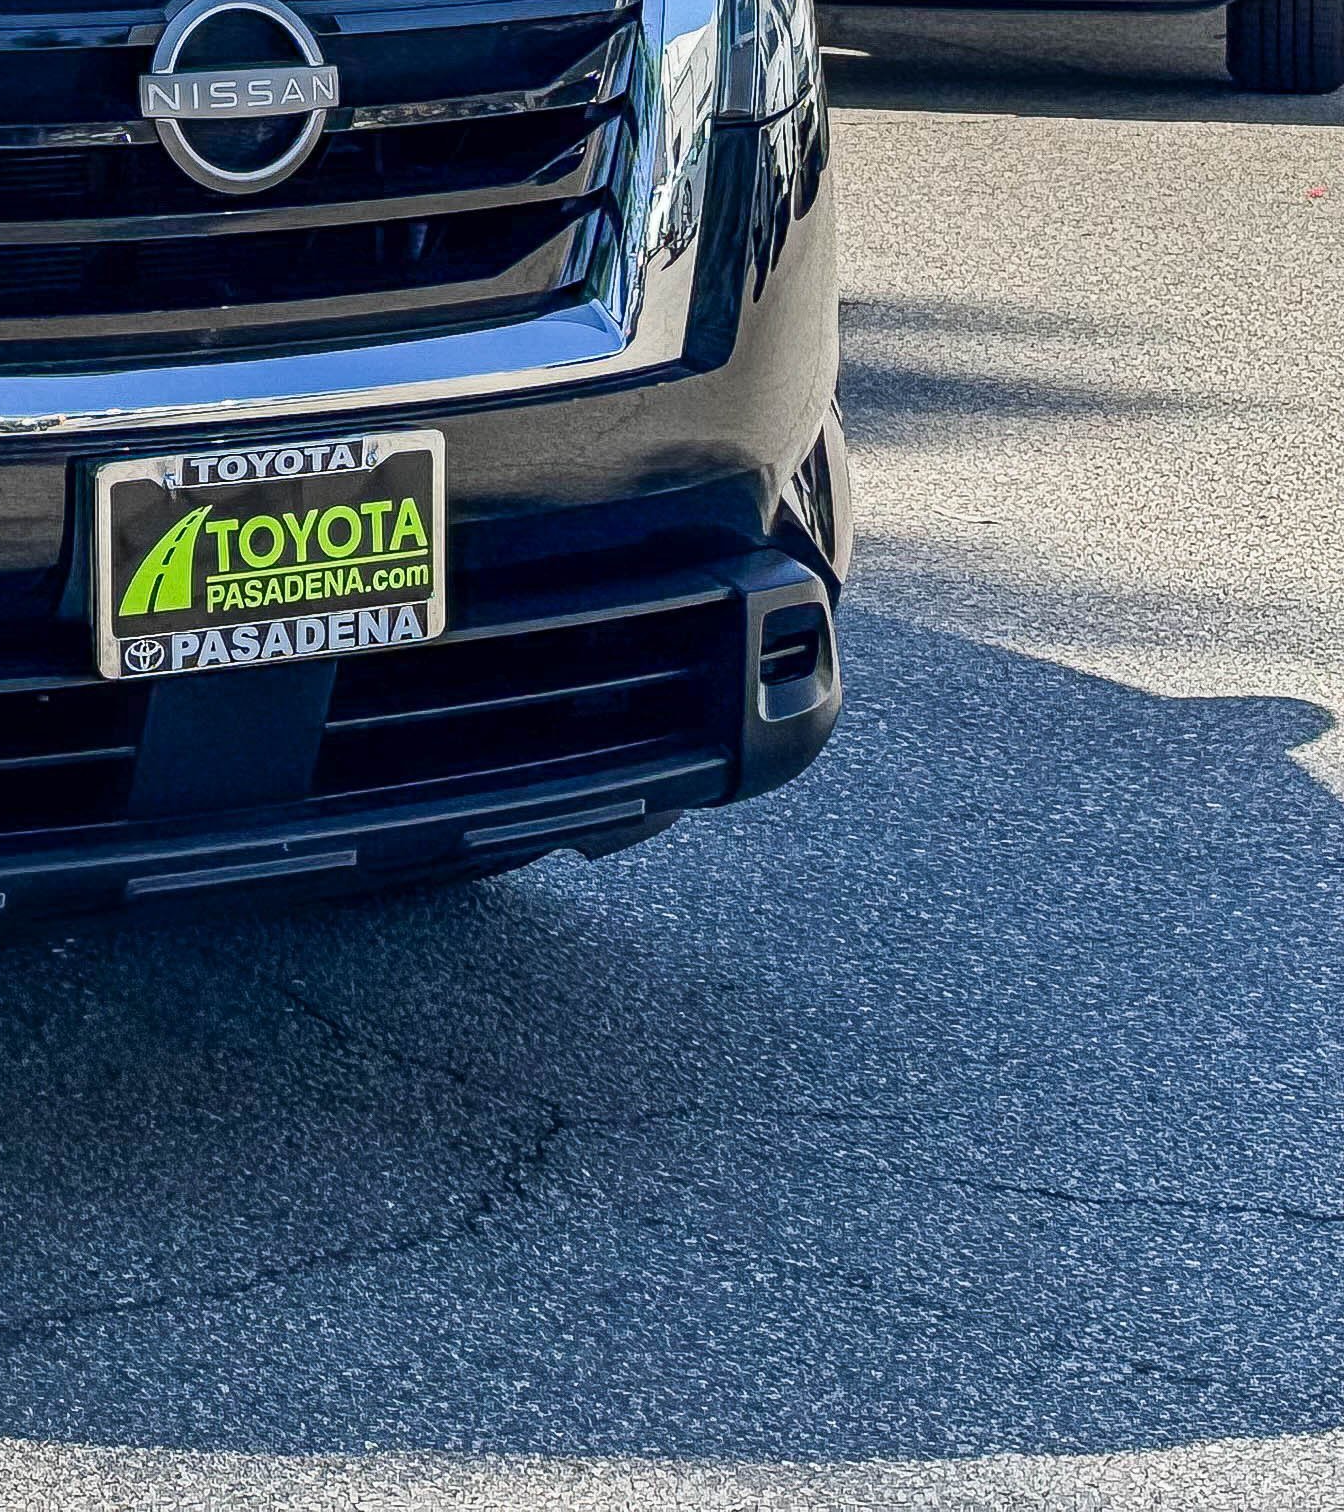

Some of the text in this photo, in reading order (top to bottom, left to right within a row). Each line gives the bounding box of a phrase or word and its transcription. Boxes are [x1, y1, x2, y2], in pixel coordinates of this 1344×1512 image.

[147, 74, 334, 111] NISSAN
[191, 444, 355, 483] TOYOTA
[205, 497, 428, 572] TOYOTA
[207, 564, 429, 613] PASADENA.com
[170, 606, 424, 670] PASADENA
